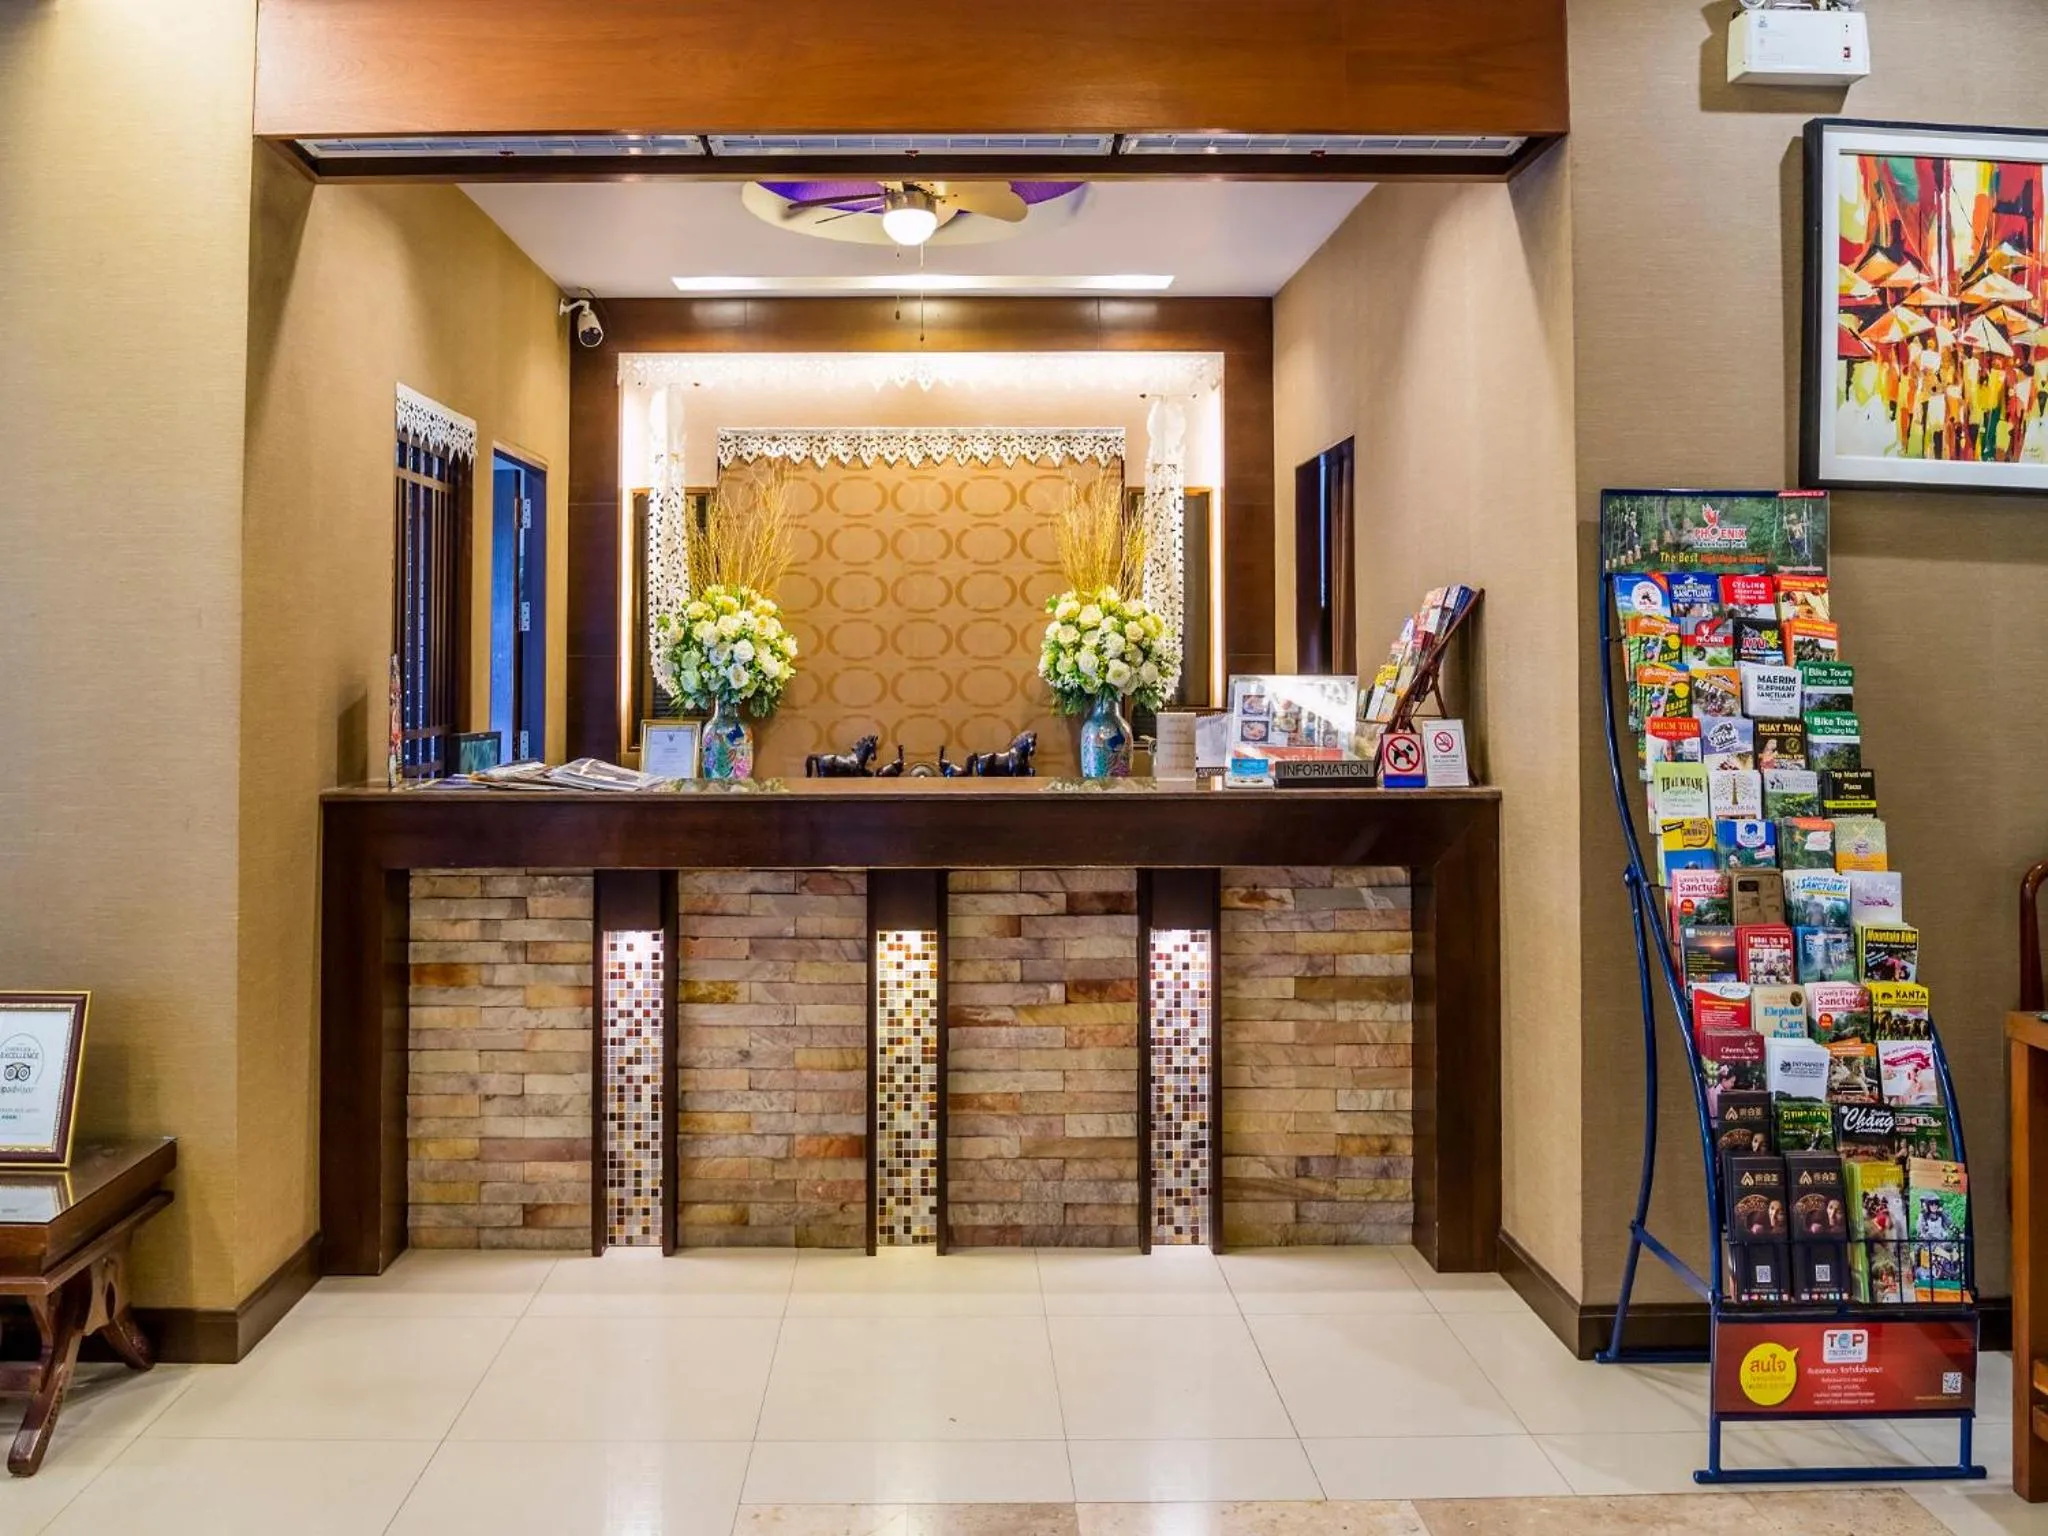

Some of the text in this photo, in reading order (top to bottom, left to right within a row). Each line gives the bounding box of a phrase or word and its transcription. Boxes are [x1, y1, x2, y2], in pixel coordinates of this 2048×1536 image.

[1660, 552, 1677, 563] The
[1679, 553, 1698, 563] Best
[1808, 668, 1853, 677] Bike Tours
[1757, 675, 1796, 684] MAERIM
[1813, 717, 1859, 726] Bike Tours
[1284, 764, 1369, 777] INFORMATION
[1896, 990, 1927, 1000] KANTA
[1764, 1007, 1803, 1017] Elephant
[1843, 1107, 1894, 1133] Chang
